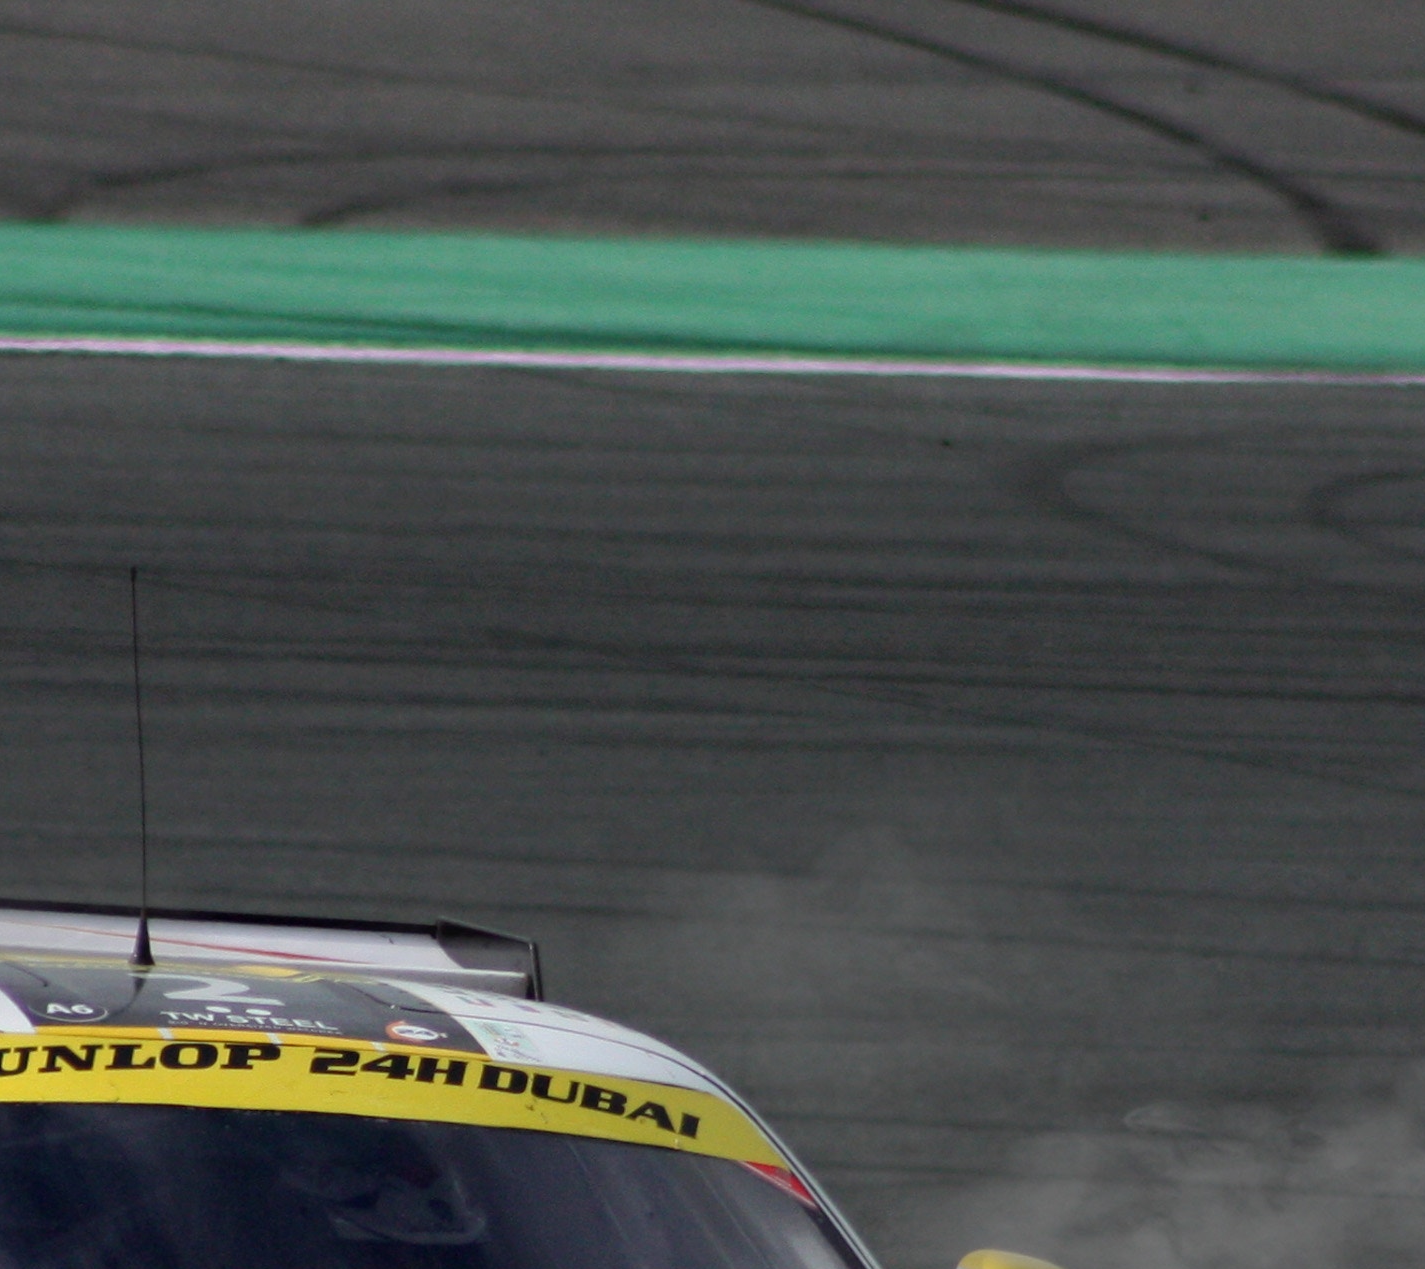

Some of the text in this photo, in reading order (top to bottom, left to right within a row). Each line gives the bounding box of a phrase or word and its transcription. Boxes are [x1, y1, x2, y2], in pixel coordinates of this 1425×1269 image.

[46, 1001, 95, 1015] A6
[160, 1011, 216, 1023] TW
[226, 1014, 340, 1031] STEEL
[310, 1048, 469, 1087] 24H
[478, 1064, 701, 1140] DUBAI
